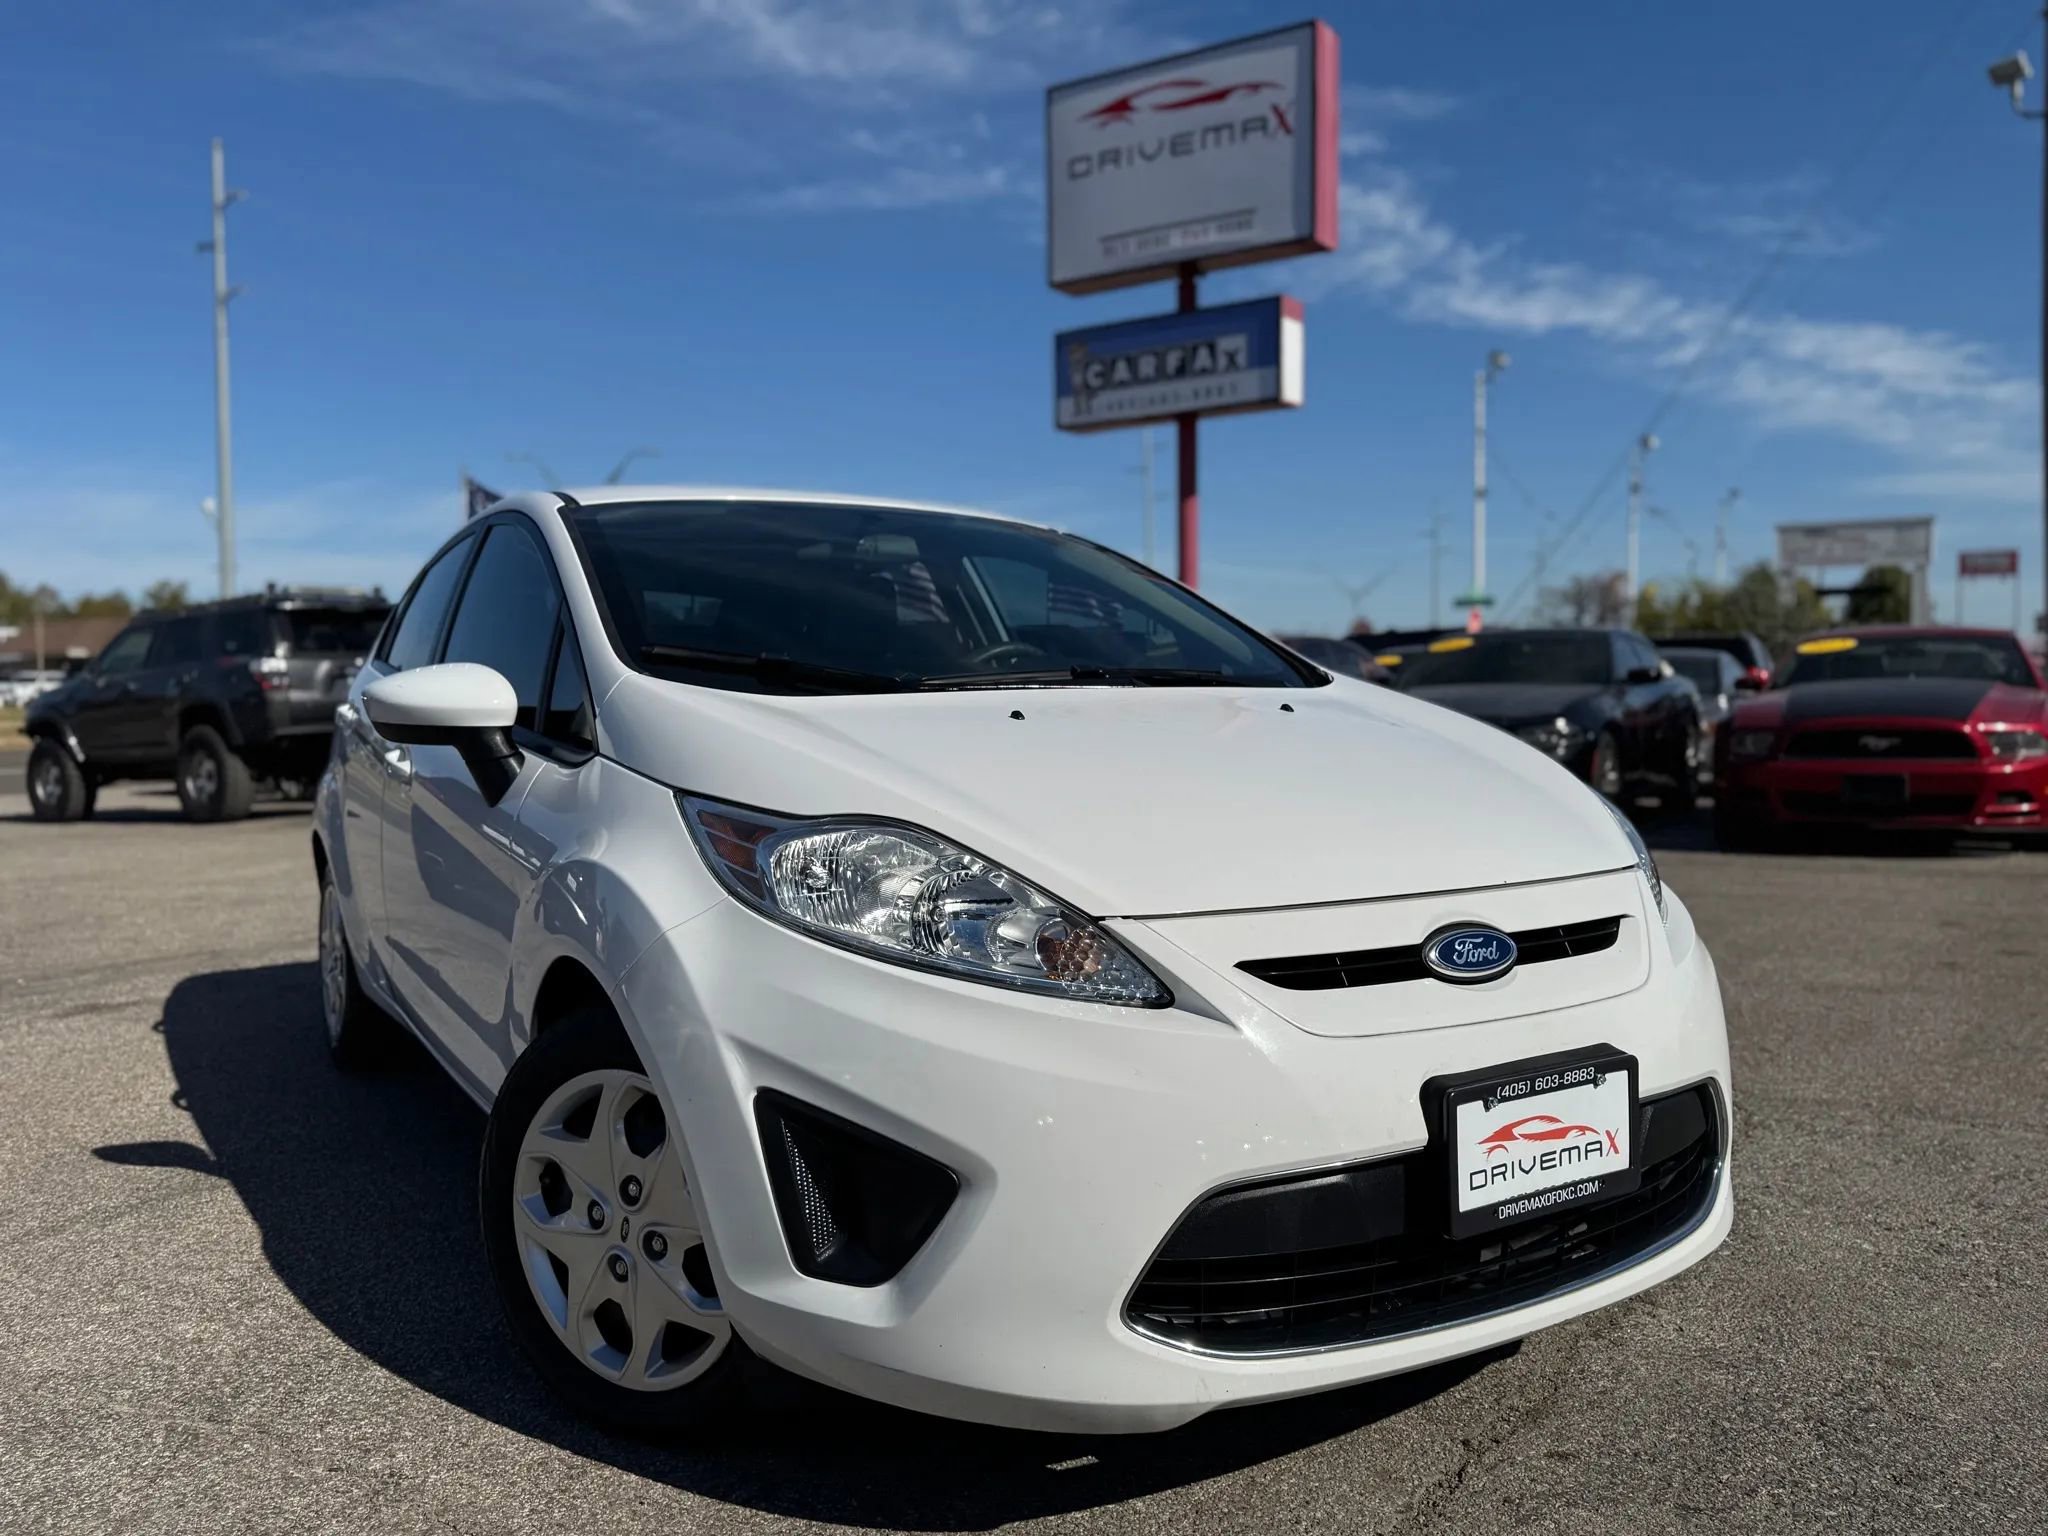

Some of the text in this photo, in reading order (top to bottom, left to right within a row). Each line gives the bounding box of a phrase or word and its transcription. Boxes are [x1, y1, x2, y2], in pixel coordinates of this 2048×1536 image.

[1066, 102, 1294, 181] DRIVEMAX
[1085, 337, 1246, 389] CARFAX
[1453, 937, 1500, 965] Ford
[1496, 1066, 1596, 1100] (405) 603-8883
[1468, 1127, 1621, 1191] DRIVEMAX
[1498, 1179, 1600, 1220] DRIVEMAXOFOKC.COM
